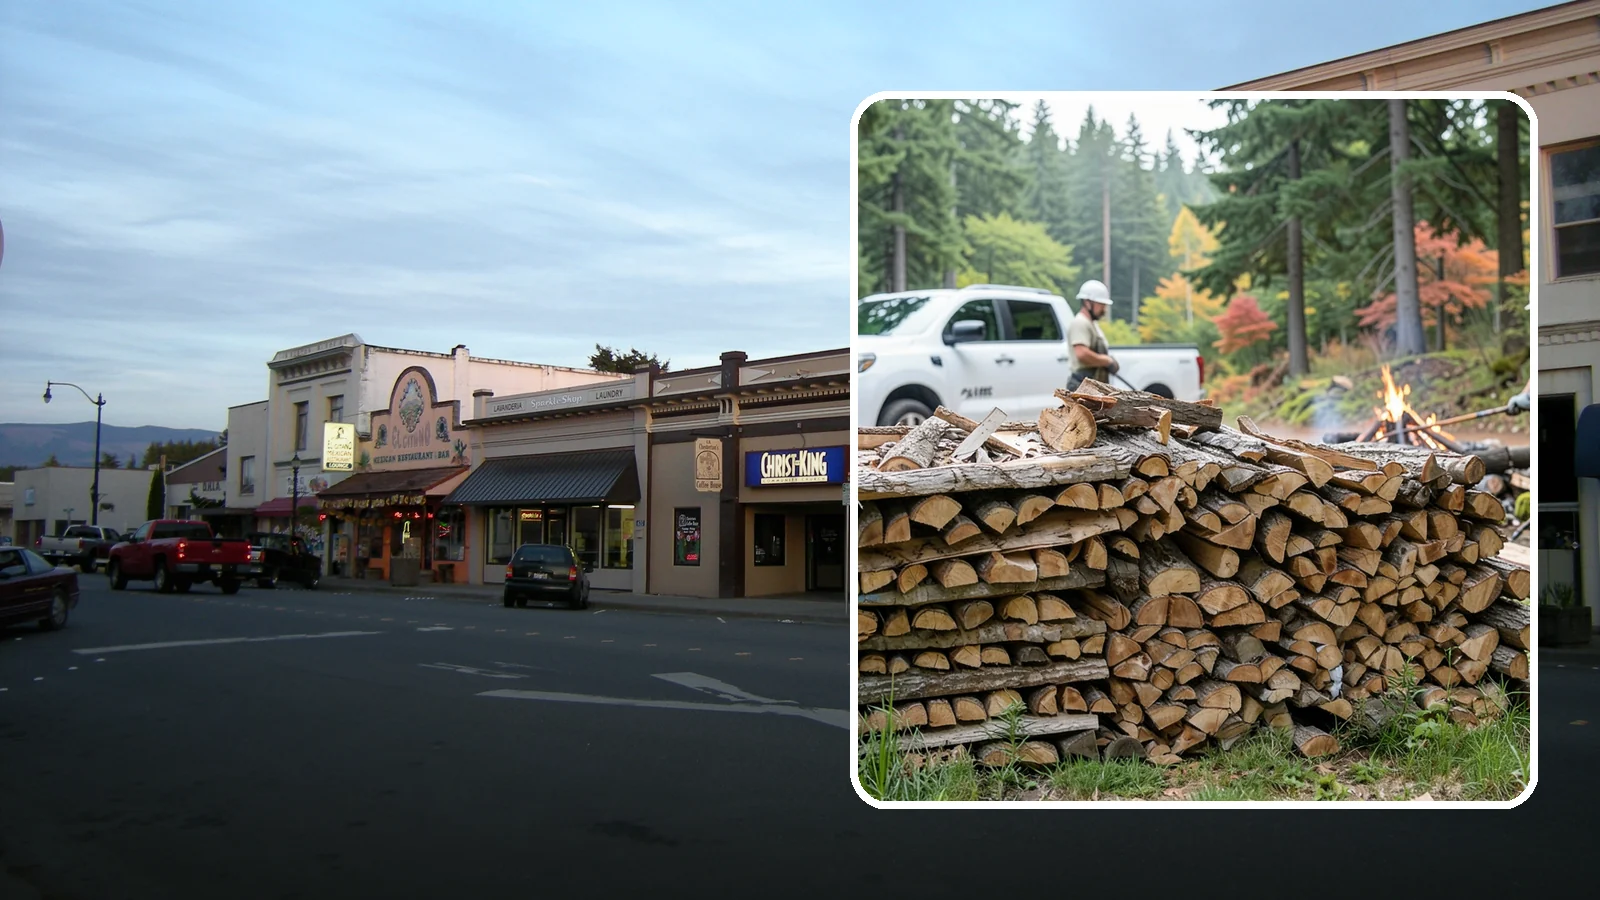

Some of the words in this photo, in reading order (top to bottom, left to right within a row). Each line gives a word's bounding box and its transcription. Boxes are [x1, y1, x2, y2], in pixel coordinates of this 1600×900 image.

[596, 389, 623, 400] LAUNDRY
[494, 402, 522, 412] LAVANDERIA
[530, 397, 560, 409] Sparkle
[562, 394, 582, 405] Shop
[374, 455, 396, 464] MEXICAN
[398, 452, 433, 462] RESTAURANT
[438, 450, 450, 459] BAR
[761, 452, 798, 477] CHRIST
[799, 450, 827, 476] KING
[697, 480, 709, 489] Coffee
[710, 480, 722, 489] House
